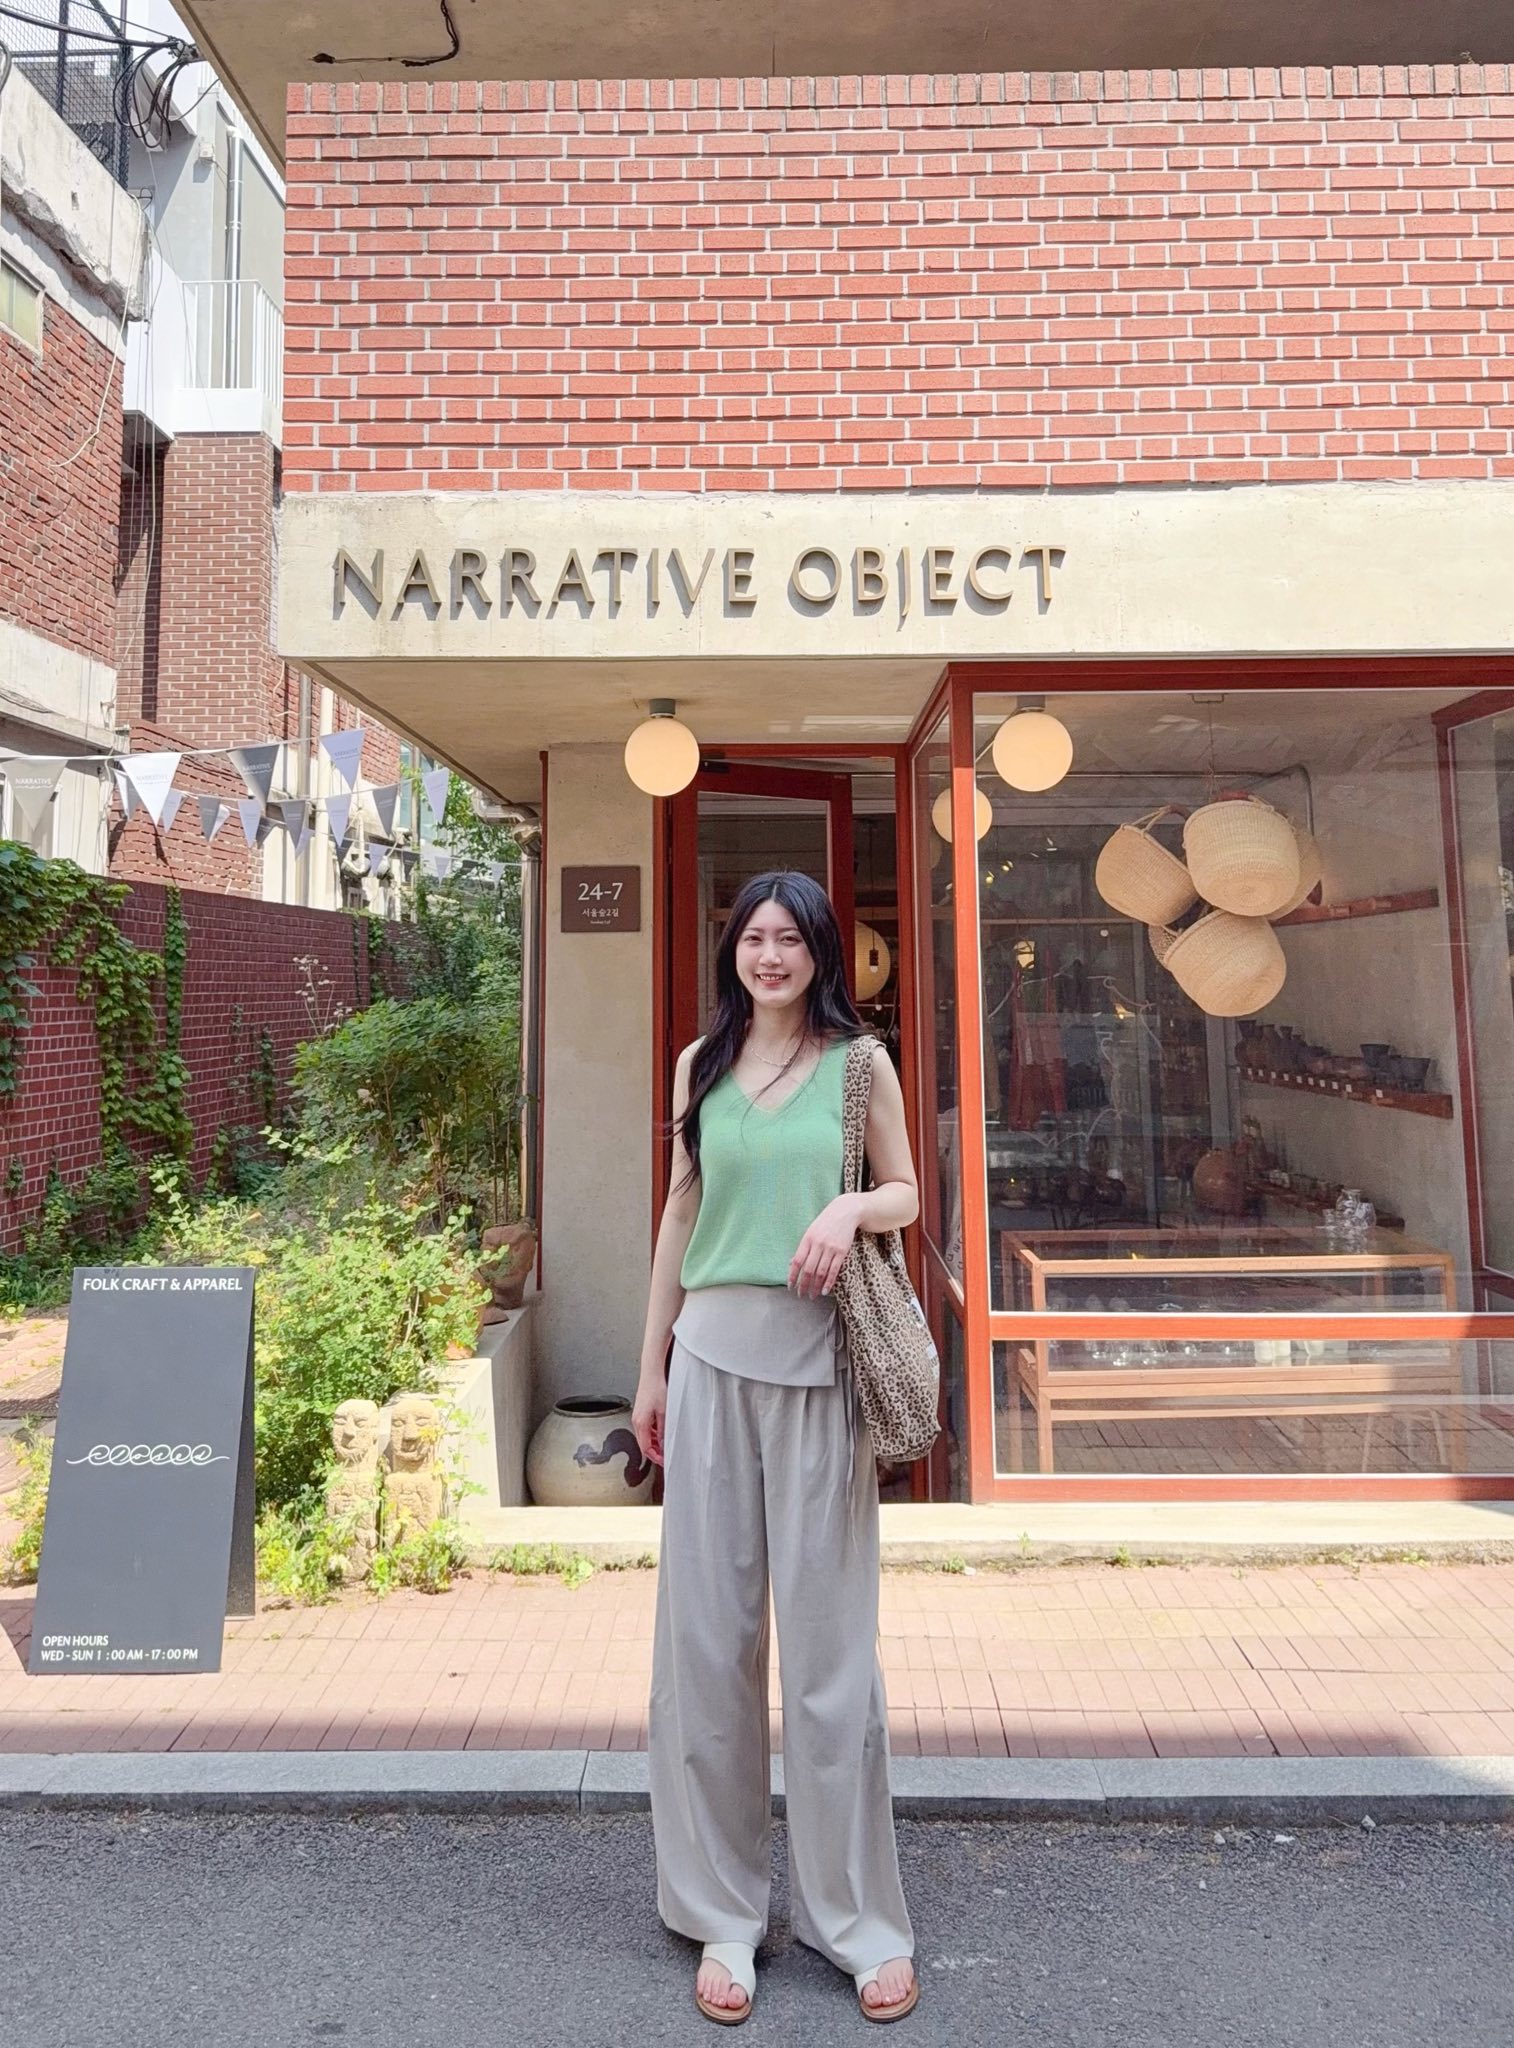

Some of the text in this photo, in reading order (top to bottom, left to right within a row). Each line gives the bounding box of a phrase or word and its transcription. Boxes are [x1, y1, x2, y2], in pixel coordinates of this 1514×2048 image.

[335, 545, 1066, 618] NARRATIVE OBJECT
[15, 777, 52, 785] NARRATIVE
[578, 883, 623, 900] 24-7
[83, 1277, 243, 1291] FOLK CRAFT & APPAREL
[42, 1635, 109, 1647] OPEN HOURS
[41, 1650, 64, 1661] WED
[72, 1650, 93, 1661] SUN
[126, 1649, 143, 1660] AM
[183, 1648, 198, 1660] PM
